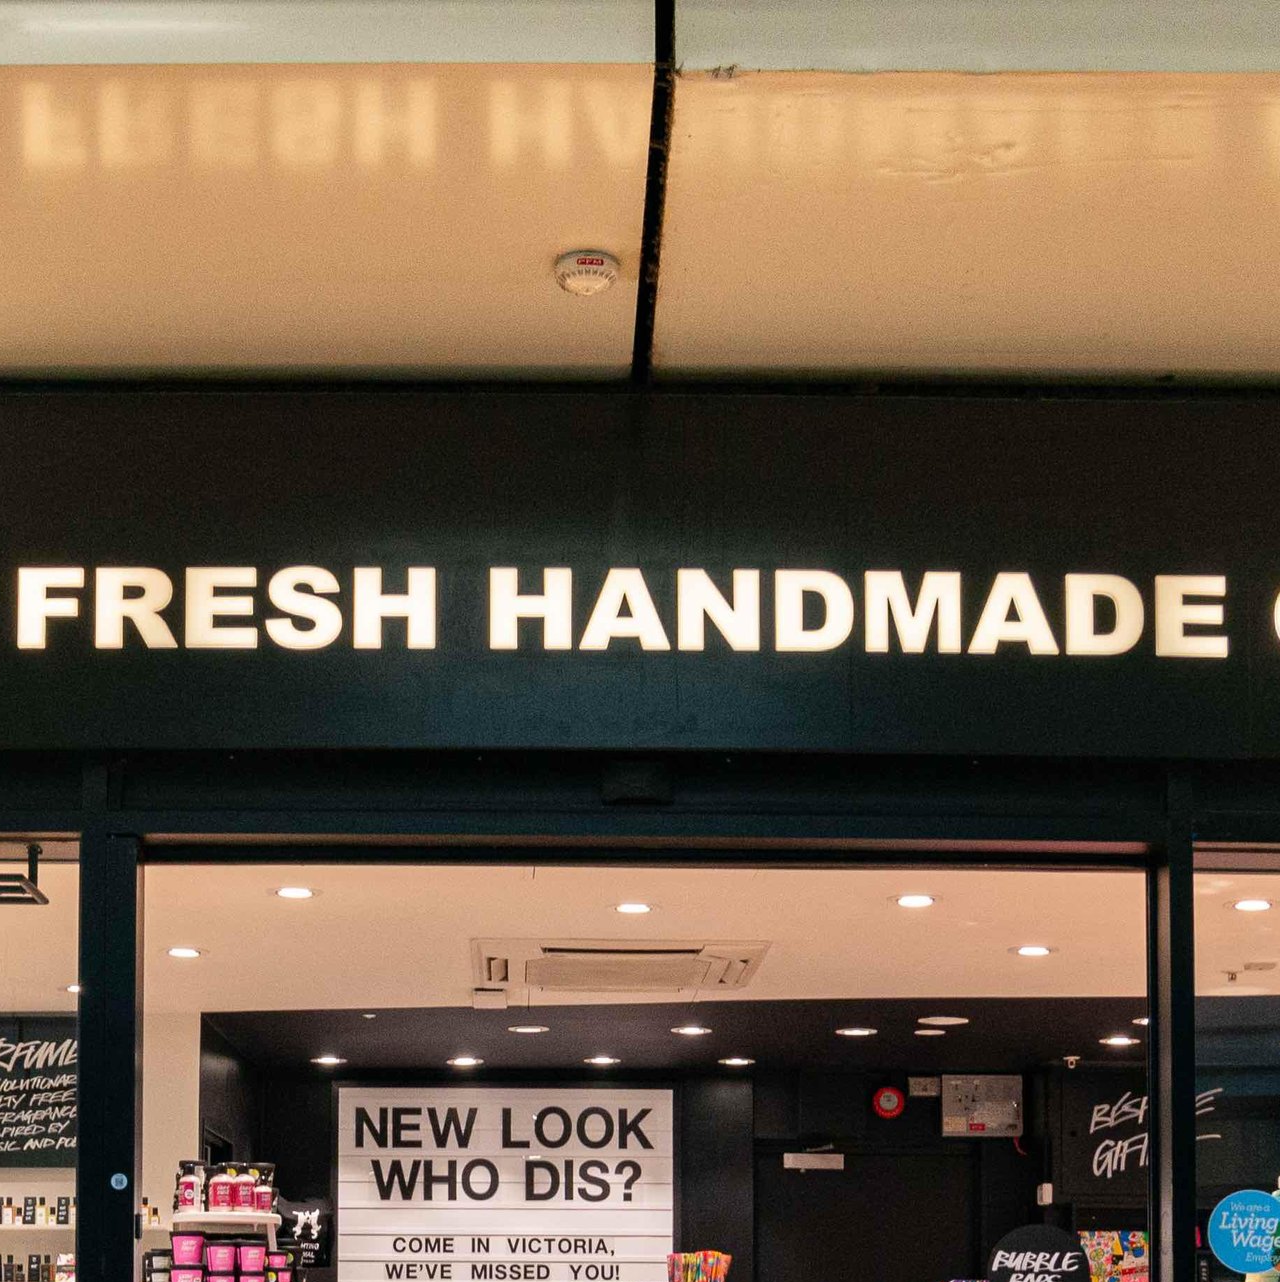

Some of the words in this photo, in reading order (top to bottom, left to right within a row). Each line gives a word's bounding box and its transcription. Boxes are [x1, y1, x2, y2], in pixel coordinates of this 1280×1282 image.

[16, 566, 438, 651] FRESH
[488, 568, 1231, 658] HANDMADE
[29, 1087, 77, 1106] FREE
[47, 1120, 70, 1134] BY
[354, 1107, 478, 1149] NEW
[502, 1106, 655, 1149] LOOK
[23, 1138, 56, 1151] AND
[371, 1159, 500, 1201] WHO
[525, 1159, 643, 1202] DIS?
[1231, 1202, 1245, 1212] We
[1246, 1204, 1262, 1212] are
[1263, 1204, 1271, 1212] a
[1219, 1211, 1279, 1234] Living
[392, 1237, 455, 1254] COME
[471, 1238, 491, 1254] IN
[507, 1238, 616, 1257] VICTORIA,
[991, 1250, 1083, 1272] BUBBLE
[385, 1263, 453, 1280] WE'VE
[471, 1263, 551, 1281] MISSED
[570, 1264, 621, 1281] YOU!
